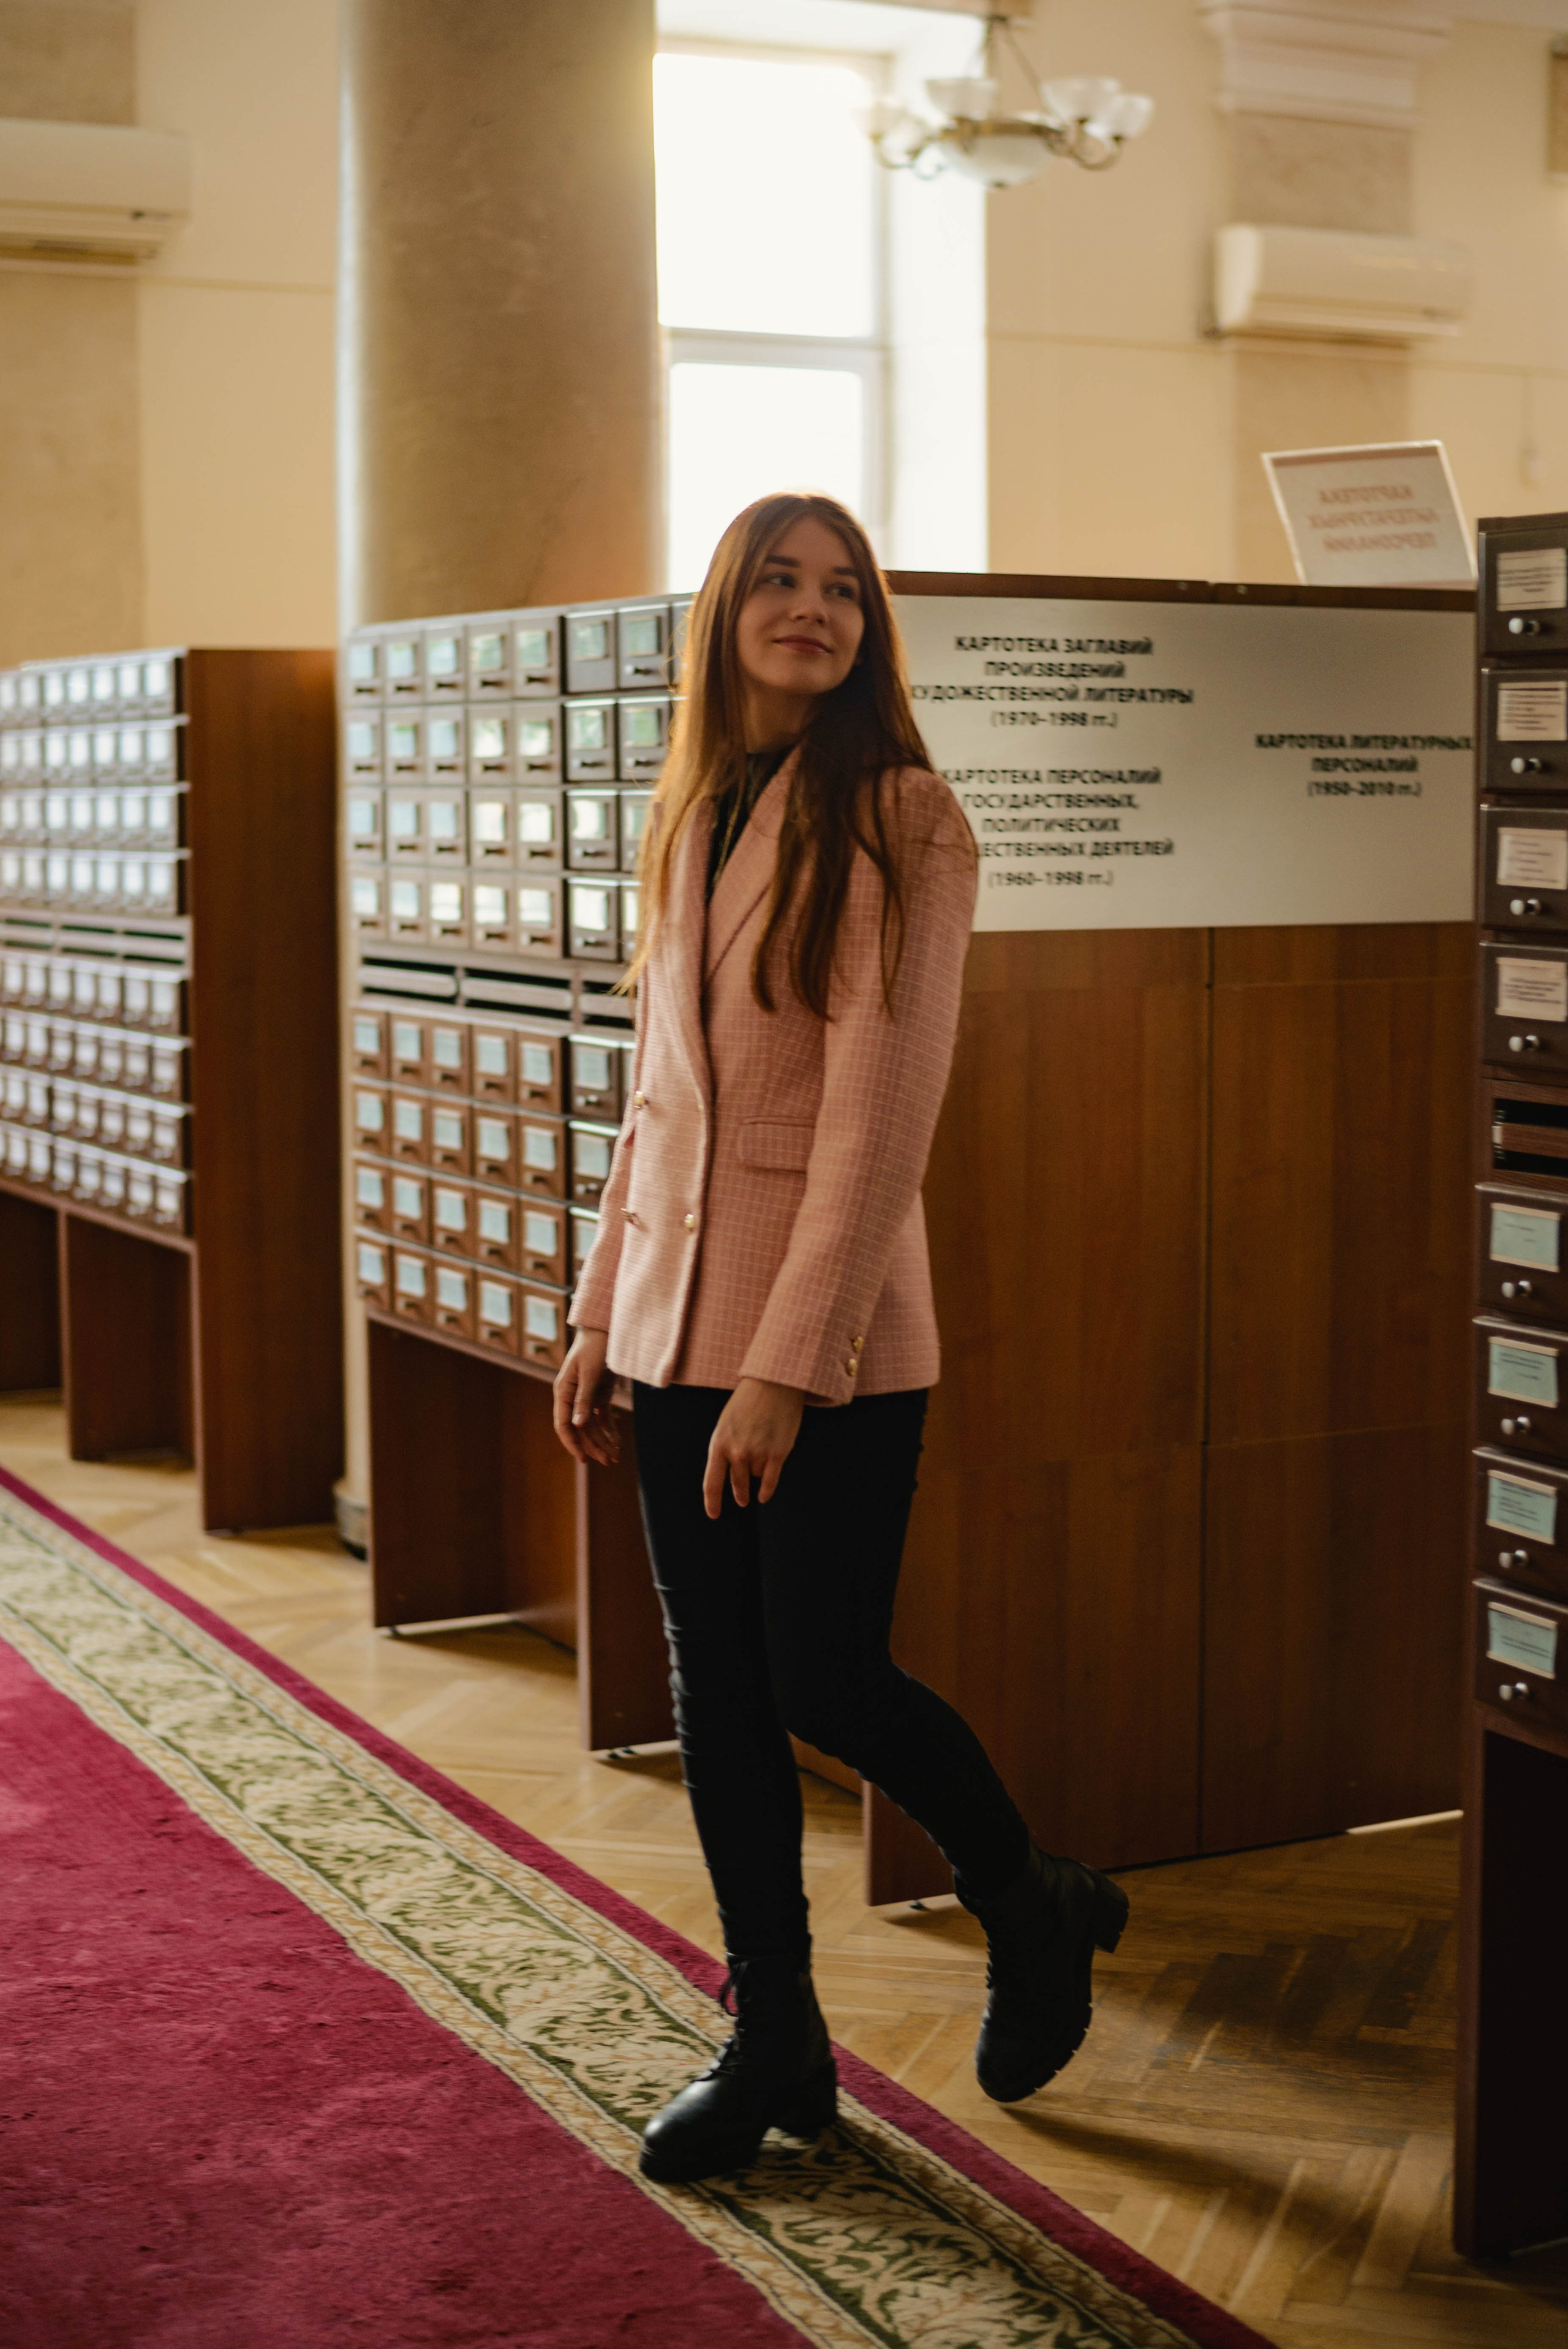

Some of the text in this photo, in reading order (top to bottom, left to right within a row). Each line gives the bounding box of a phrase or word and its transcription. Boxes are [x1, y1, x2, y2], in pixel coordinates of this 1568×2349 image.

[954, 636, 1153, 655] КАРТОТЕКА ЗАГЛАВИЙ
[984, 660, 1125, 679] ПРОИЗВЕДЕНИЙ
[1086, 687, 1193, 704] ЛИТЕРАТУРЫ
[1254, 734, 1346, 749] КАРТОТЕКА
[1311, 755, 1419, 773] ПЕРСОНАЛИЙ
[1047, 766, 1161, 784] ПЕРСОНАЛИЙ
[963, 793, 1139, 810] ГОСУДАРСТВЕННЫХ,
[982, 818, 1121, 833] ПОЛИТИЧЕСКИХ
[978, 837, 1174, 859] ЕСТВЕННЫХ ДЕЯТЕЛЕЙ
